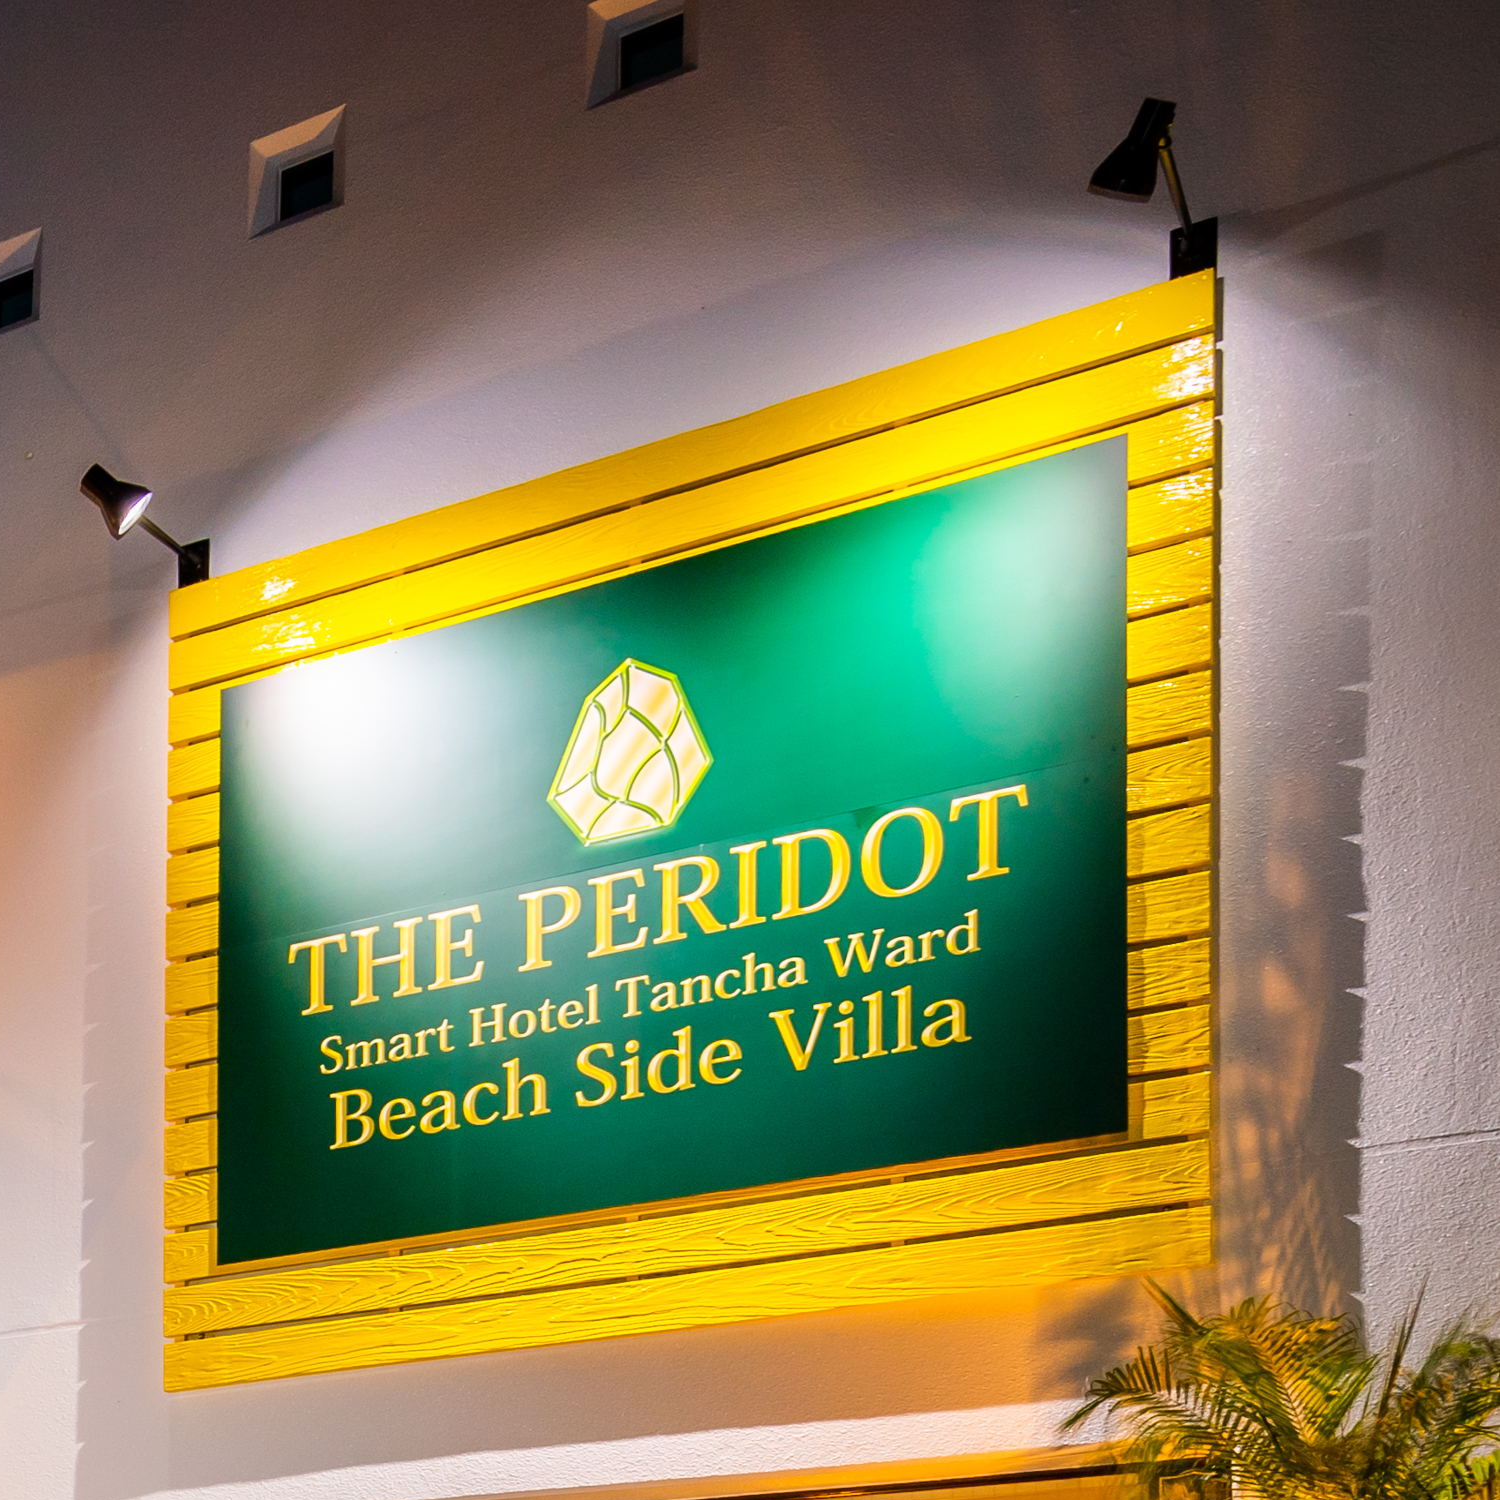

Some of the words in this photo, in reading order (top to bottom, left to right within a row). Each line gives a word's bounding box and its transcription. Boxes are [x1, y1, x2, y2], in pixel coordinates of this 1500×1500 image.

[287, 902, 485, 1018] THE
[516, 783, 1030, 974] PERIDOT
[318, 1018, 456, 1076] Smart
[468, 983, 601, 1049] Hotel
[613, 952, 809, 1019] Tancha
[823, 908, 982, 979] Ward
[329, 1057, 551, 1151] Beach
[573, 1025, 743, 1109] Side
[768, 984, 973, 1072] Villa
